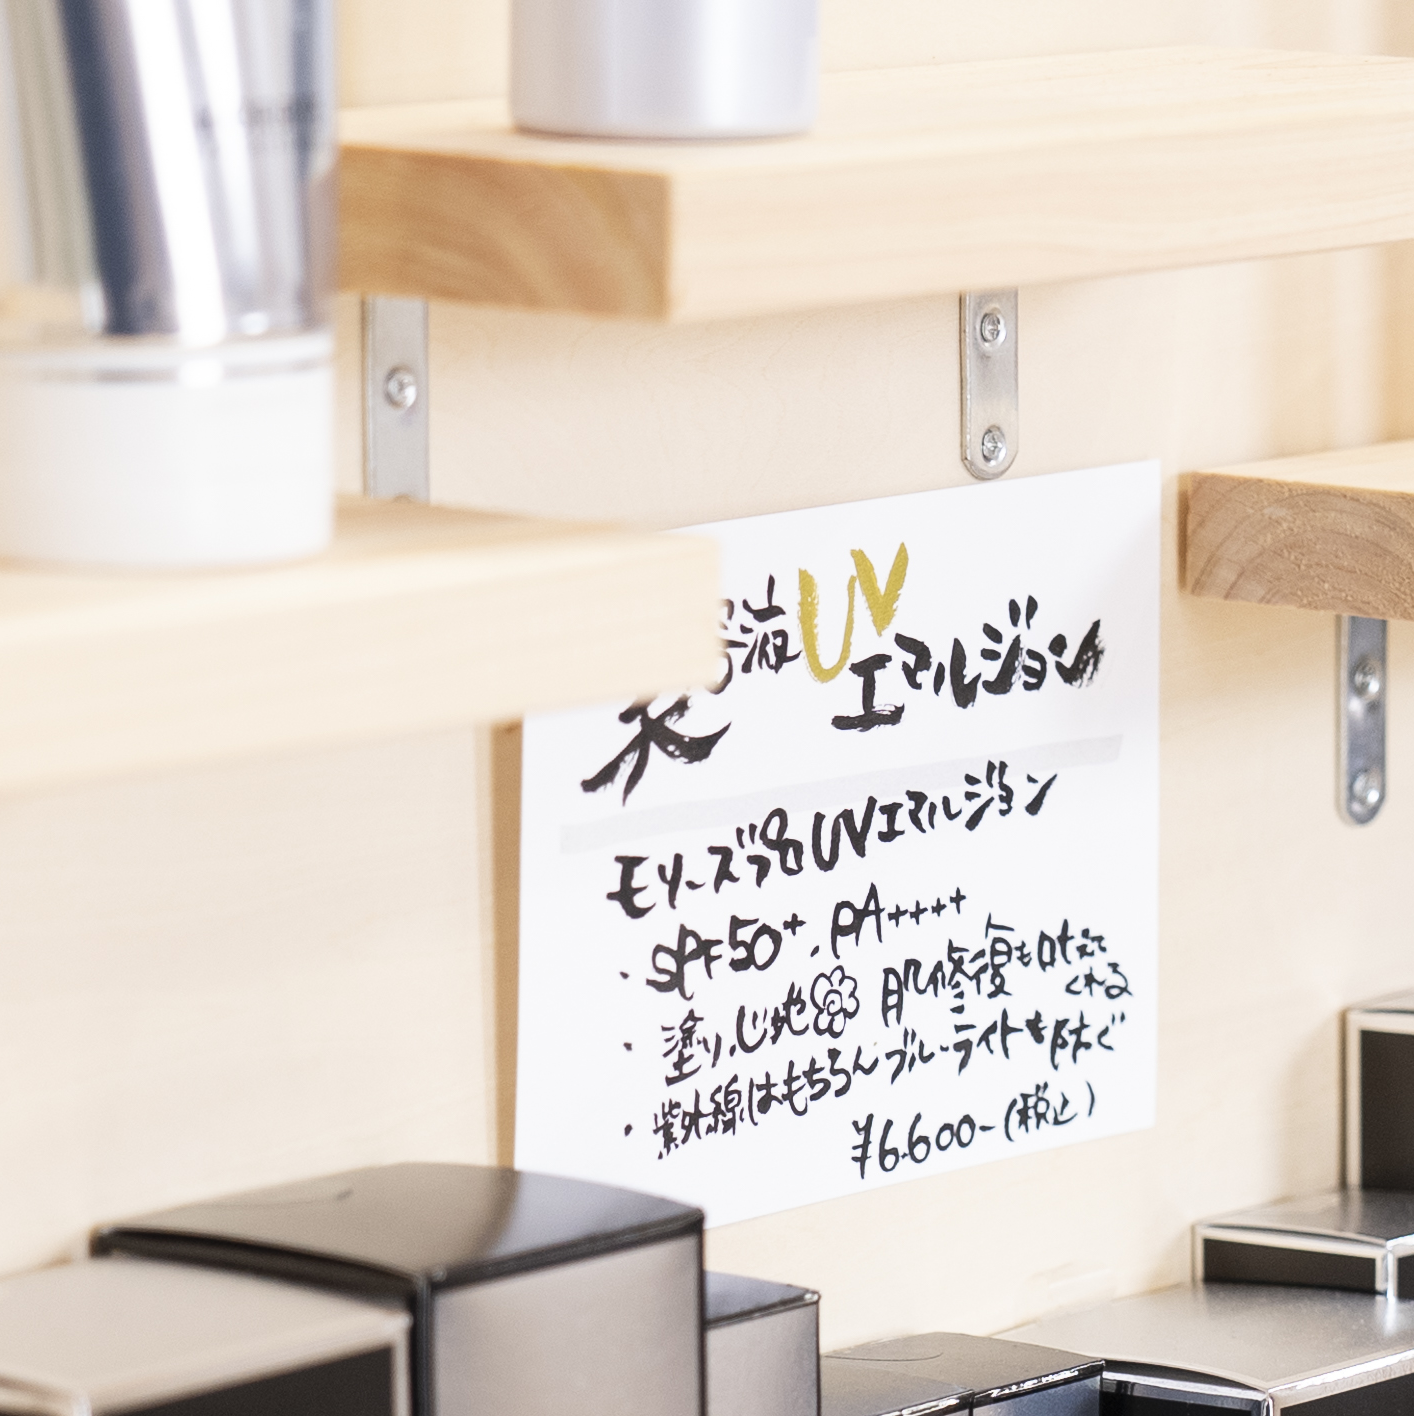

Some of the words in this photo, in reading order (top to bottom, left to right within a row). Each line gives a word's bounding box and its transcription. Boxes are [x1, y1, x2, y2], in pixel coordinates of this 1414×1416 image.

[831, 595, 1106, 731] エマルジョン
